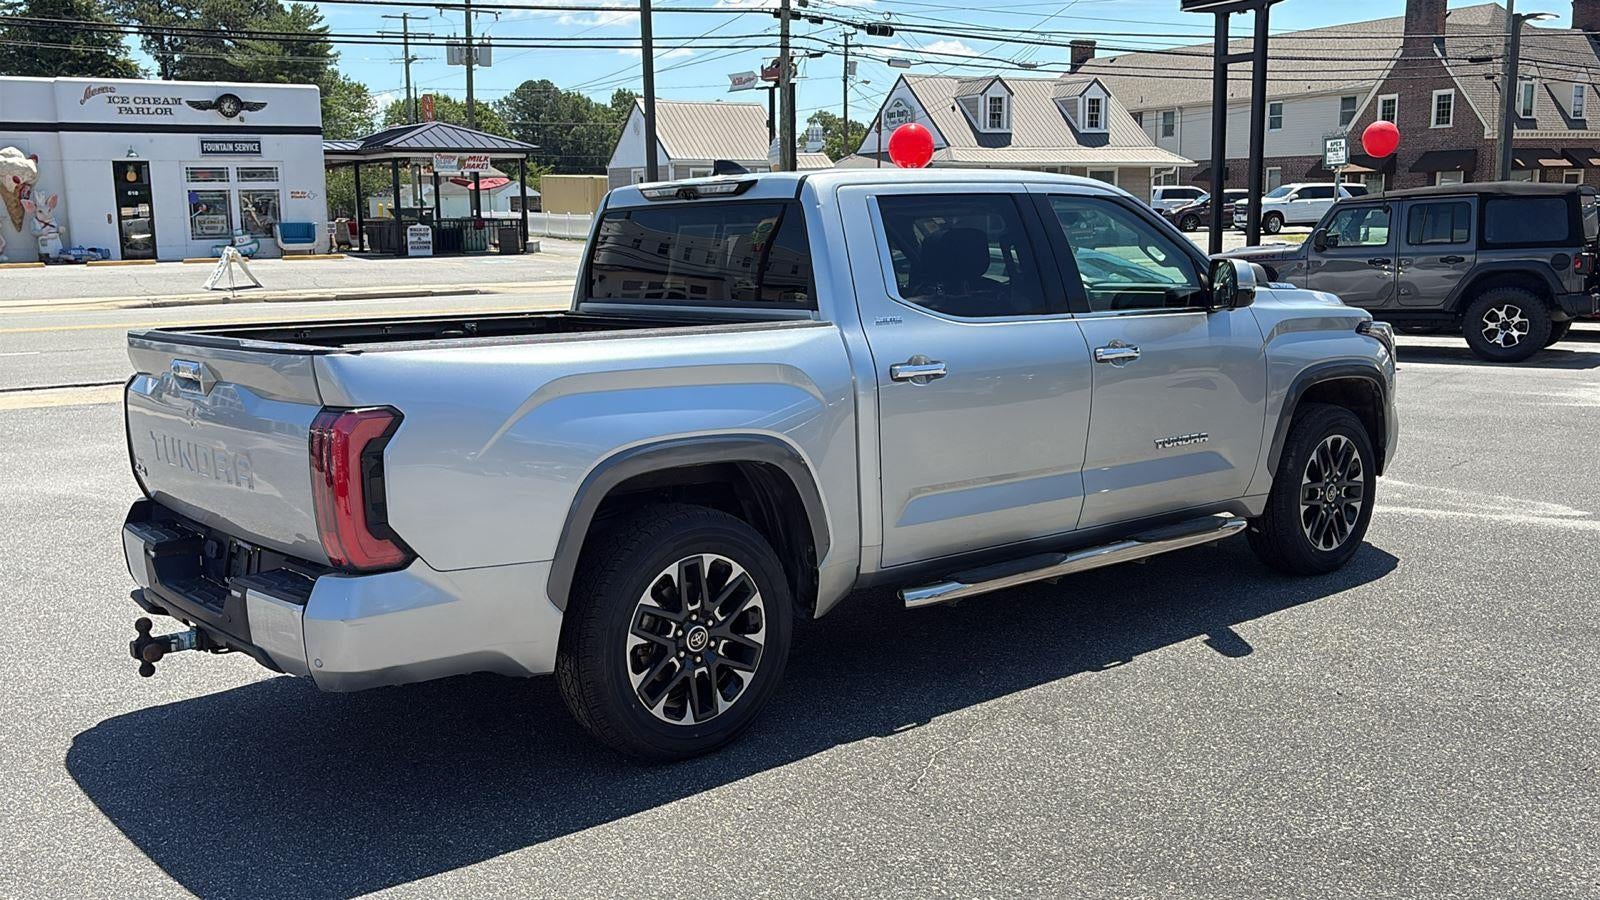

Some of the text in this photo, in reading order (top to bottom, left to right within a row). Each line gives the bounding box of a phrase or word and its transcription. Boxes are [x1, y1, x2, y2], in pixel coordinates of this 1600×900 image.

[107, 96, 182, 105] ICE CREAM
[118, 106, 174, 115] PARLOR
[203, 142, 259, 151] FOUNTAIN SERVICE
[1154, 432, 1208, 449] TUNDRA
[150, 430, 255, 490] TUNDRA
